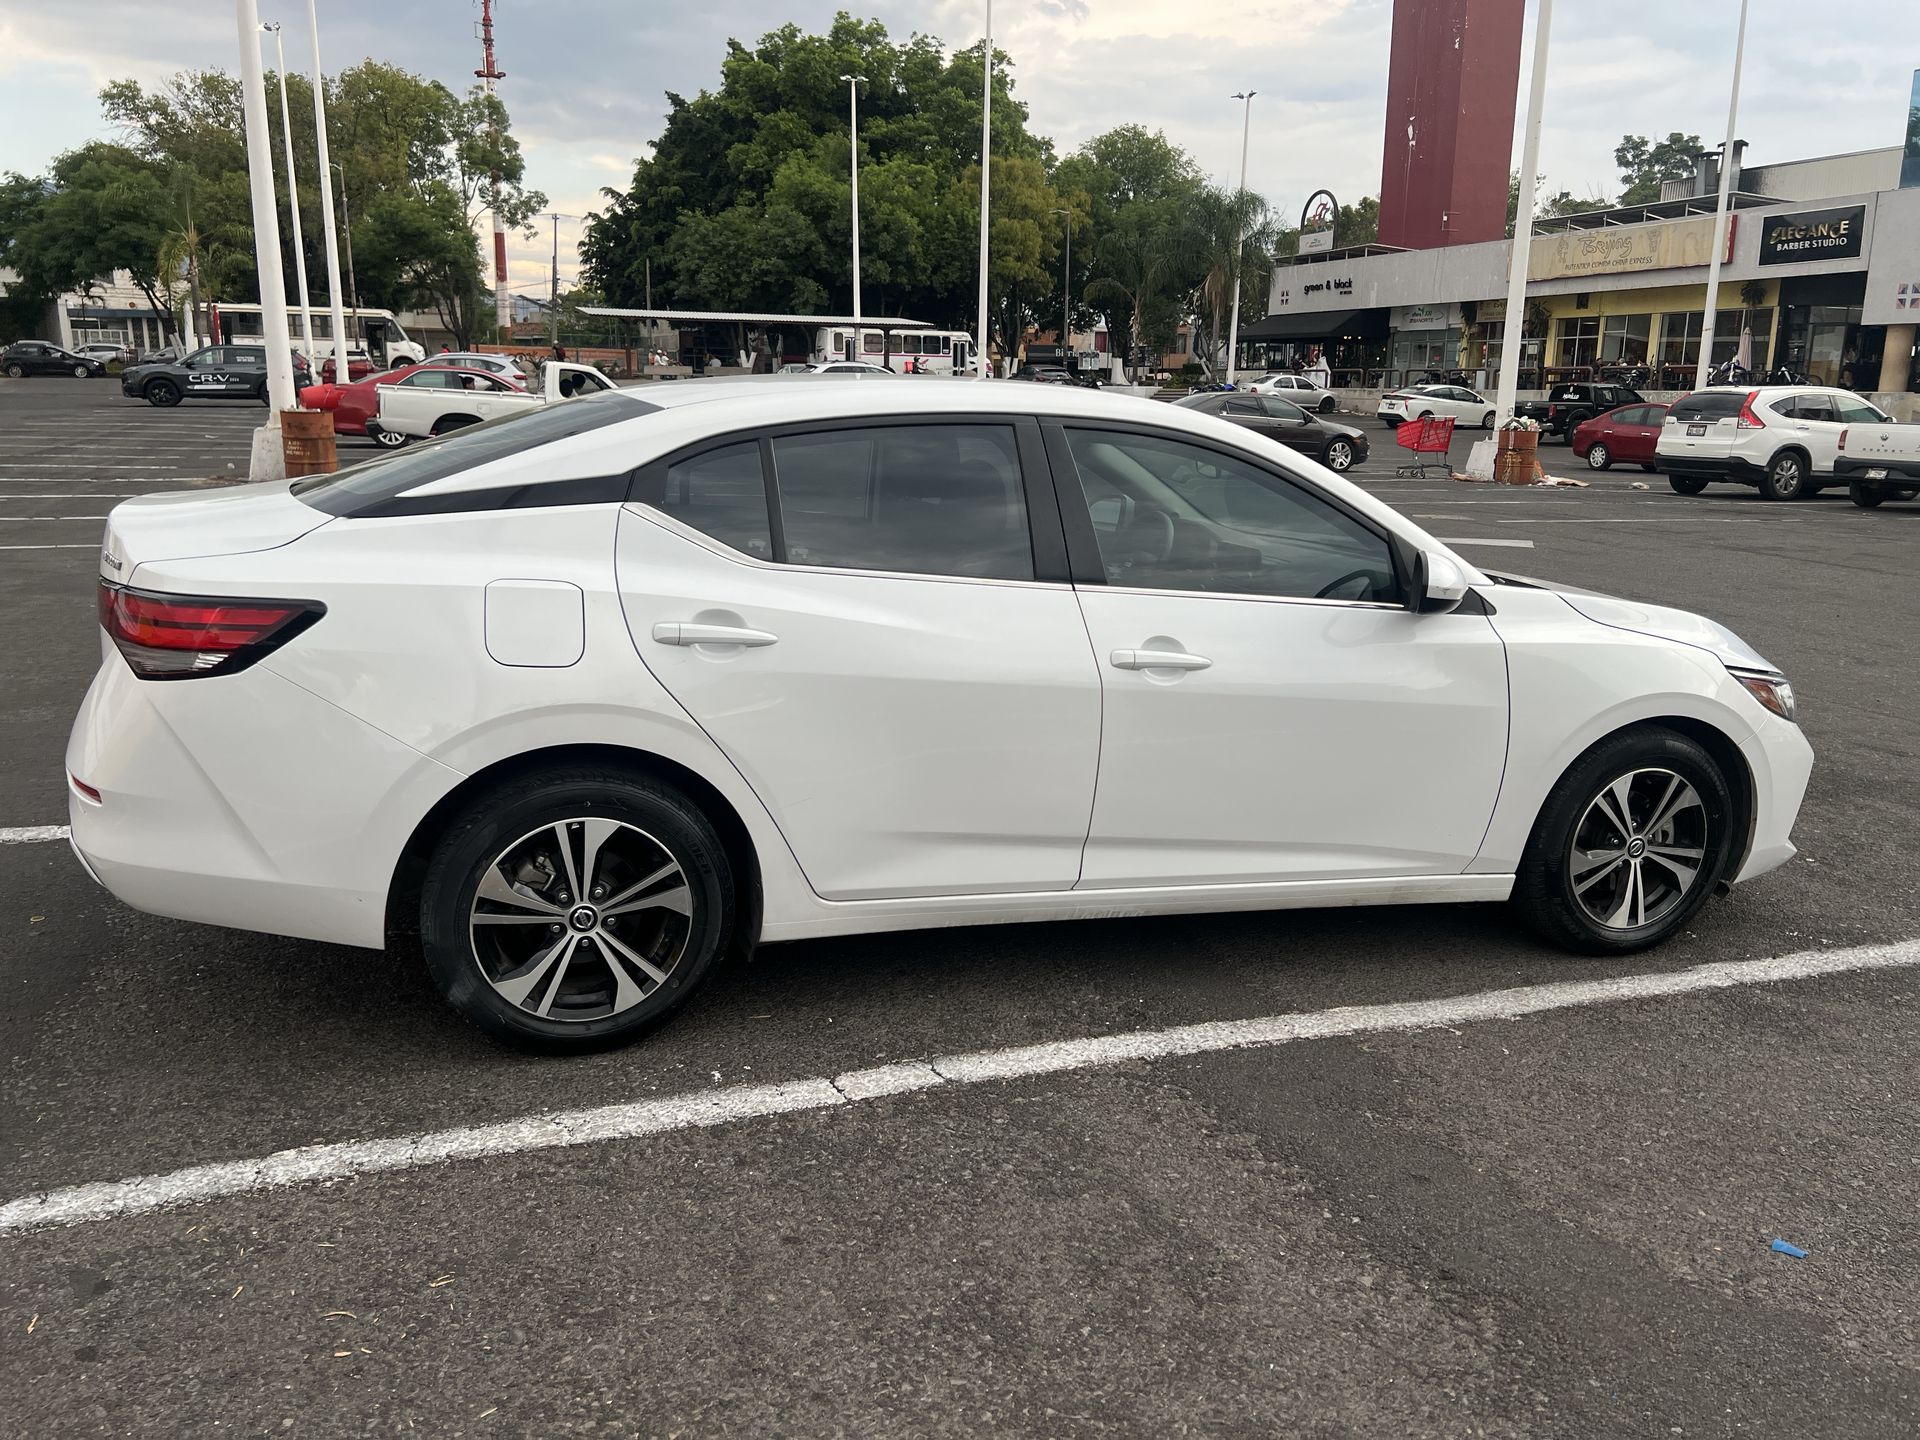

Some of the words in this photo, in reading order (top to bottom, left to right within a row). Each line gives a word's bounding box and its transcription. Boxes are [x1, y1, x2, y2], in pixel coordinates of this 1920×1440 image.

[1769, 220, 1850, 244] ELEGANCE
[1776, 241, 1810, 252] BARBER
[1812, 237, 1848, 248] STUDIO
[1629, 256, 1653, 265] EXPRESS
[1303, 283, 1324, 296] green
[1333, 277, 1353, 289] black
[1055, 348, 1079, 358] Biria
